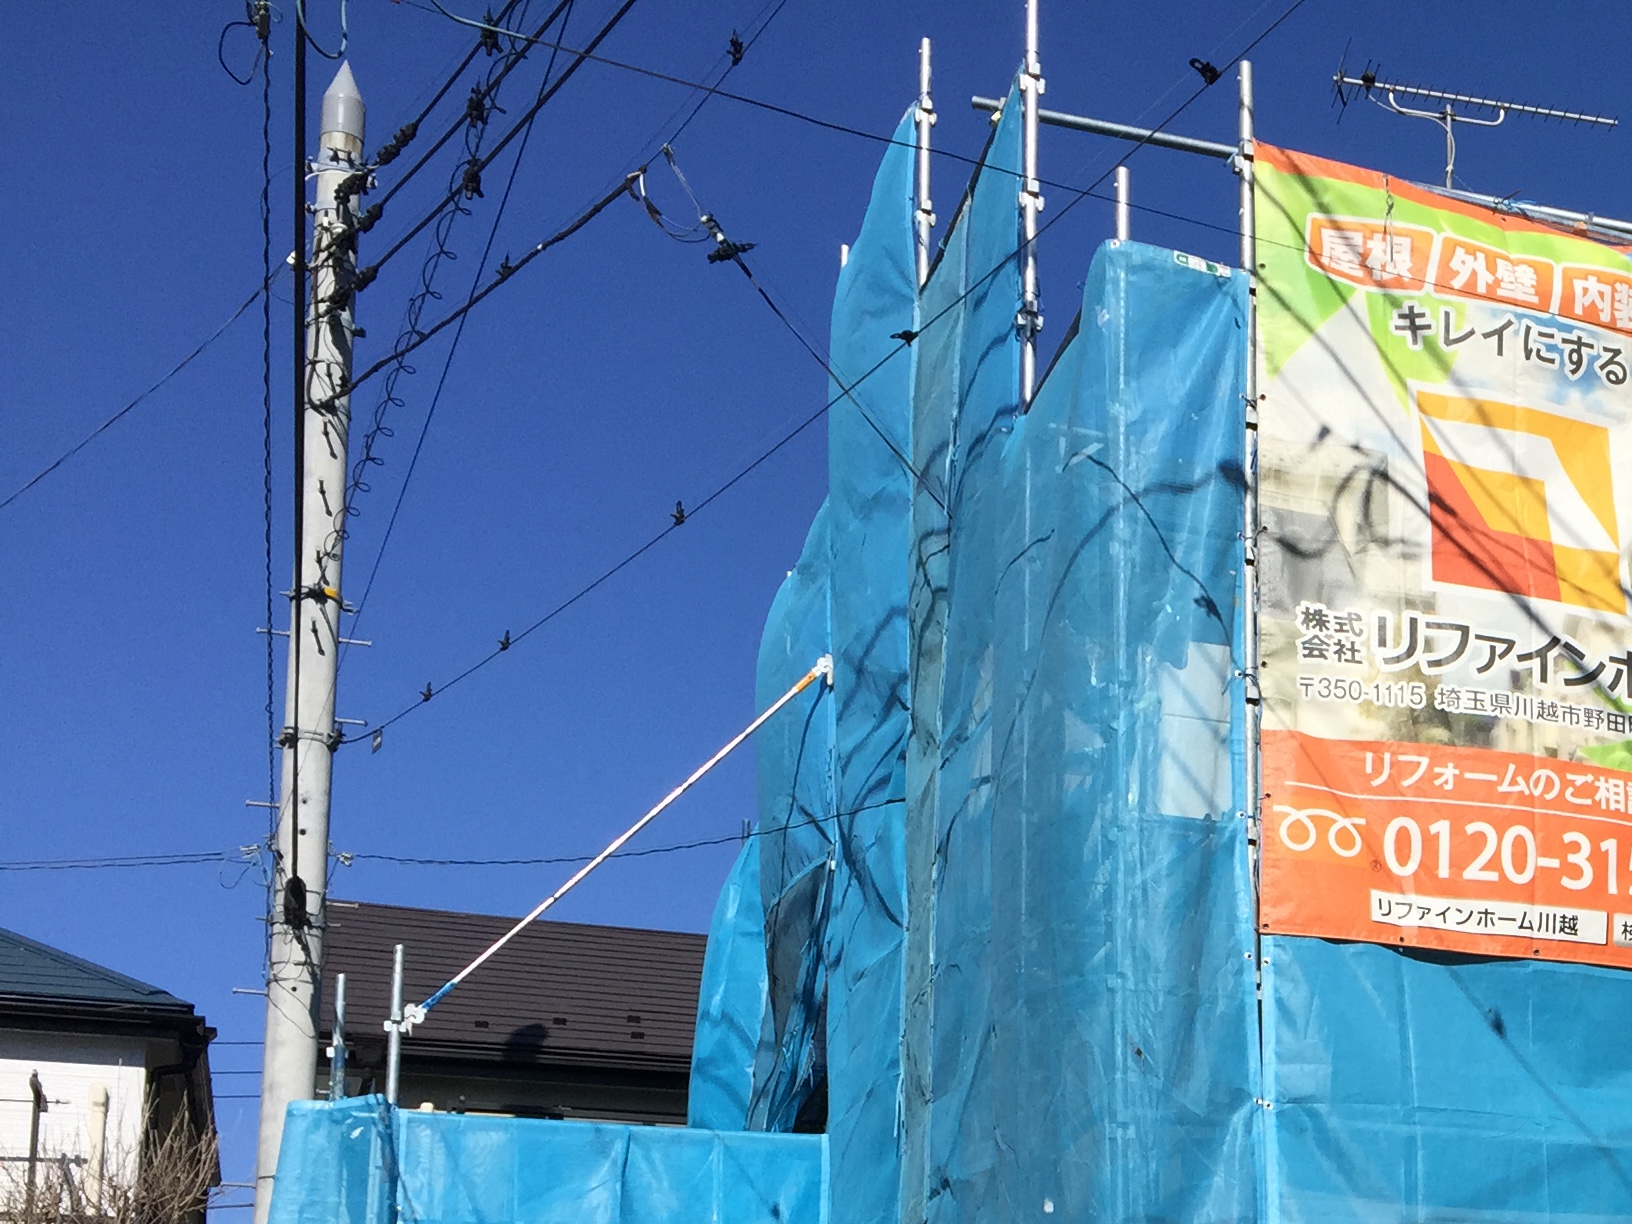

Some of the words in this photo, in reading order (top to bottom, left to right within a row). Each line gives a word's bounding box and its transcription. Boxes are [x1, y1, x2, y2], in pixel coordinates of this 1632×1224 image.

[1320, 227, 1415, 284] 屋根
[1448, 248, 1541, 305] 外壁
[1394, 304, 1629, 386] キレイにする
[1299, 606, 1363, 637] 株式
[1299, 636, 1363, 665] 会社
[1377, 897, 1579, 936] リファインホーム川越
